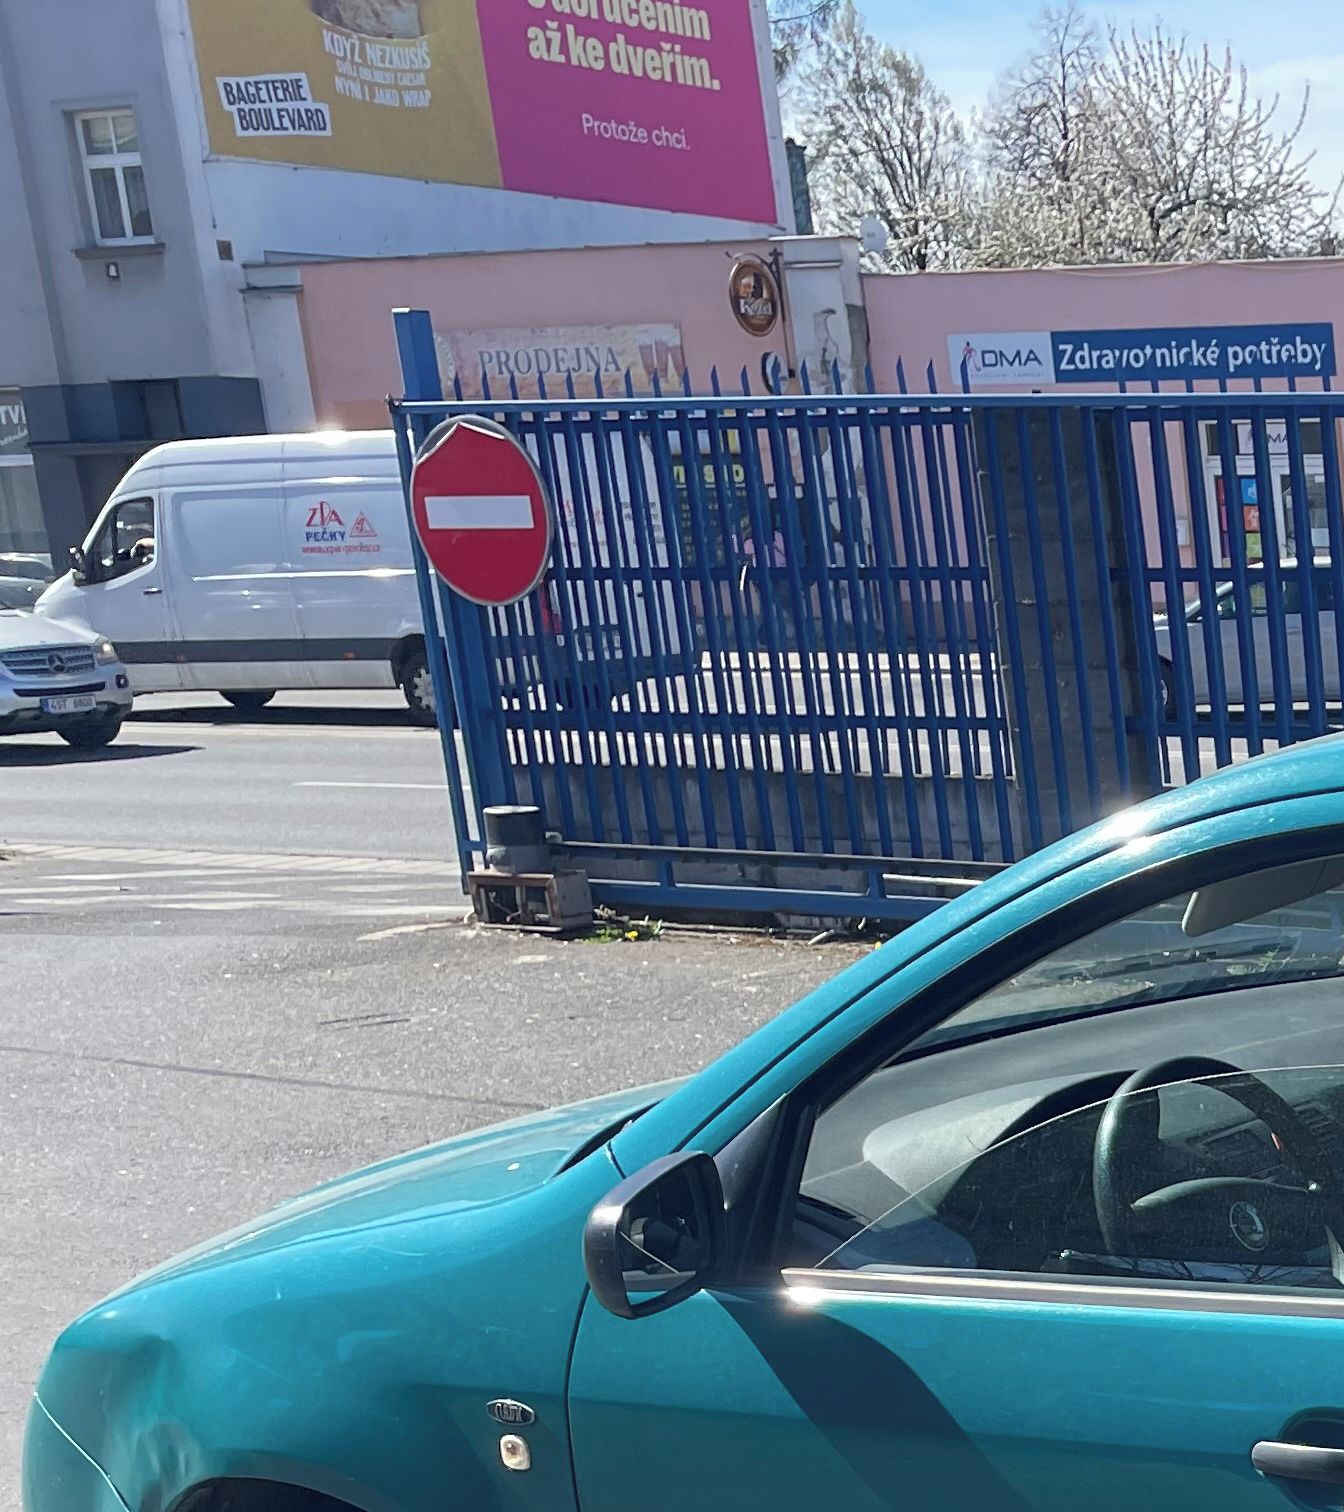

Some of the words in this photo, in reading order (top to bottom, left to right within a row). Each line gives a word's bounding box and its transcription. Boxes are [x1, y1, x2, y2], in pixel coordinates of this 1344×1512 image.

[527, 20, 566, 63] až
[566, 24, 605, 71] ke
[223, 78, 308, 106] BAGETERIE
[237, 107, 328, 132] BOULEVARD
[581, 113, 649, 144] Protože
[651, 126, 691, 150] chci.
[478, 346, 622, 376] PRODEJNA
[981, 349, 1043, 368] DMA
[1227, 336, 1328, 373] potřeby
